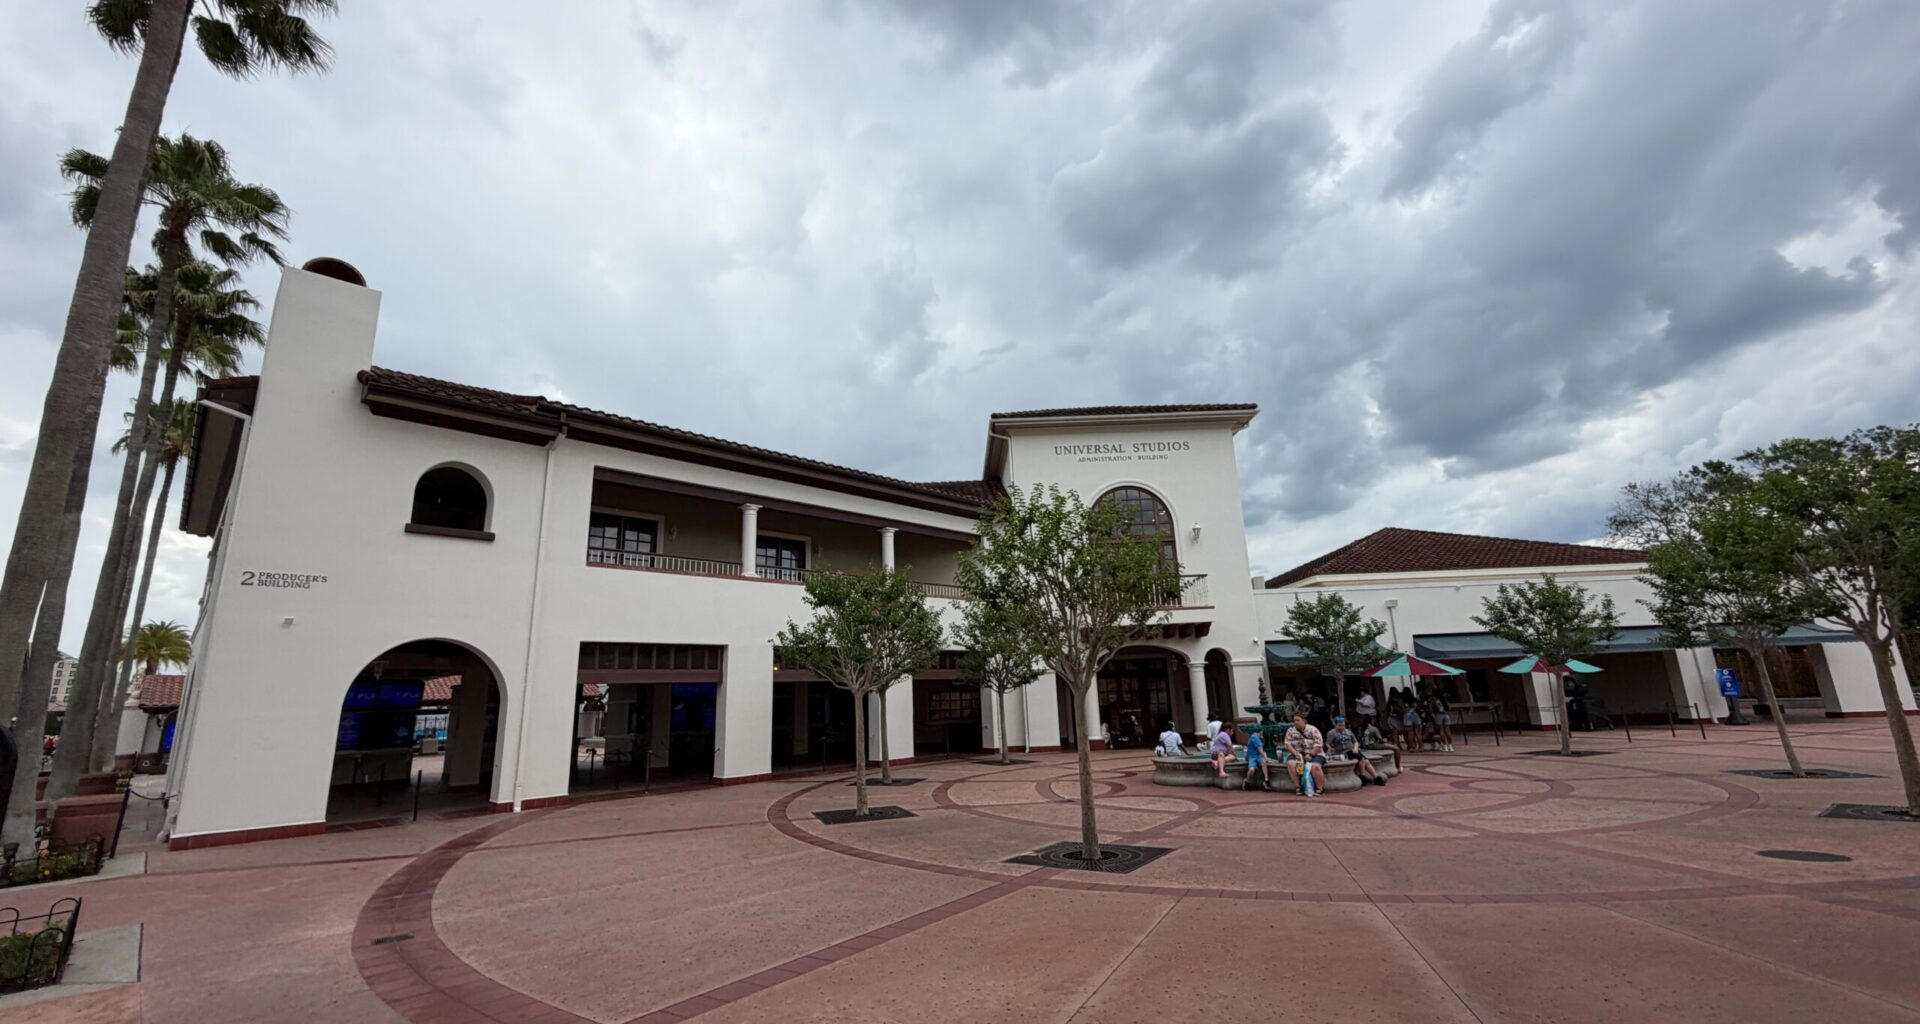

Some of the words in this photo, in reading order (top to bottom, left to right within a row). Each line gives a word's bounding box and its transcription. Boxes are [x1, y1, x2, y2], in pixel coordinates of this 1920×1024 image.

[1054, 443, 1126, 456] UNIVERSAL
[1132, 441, 1190, 453] STUDIOS
[1078, 455, 1132, 463] ADMINISTRATION
[240, 571, 256, 586] 2
[258, 571, 328, 583] PRODUCER'S
[257, 579, 311, 590] BUILDING
